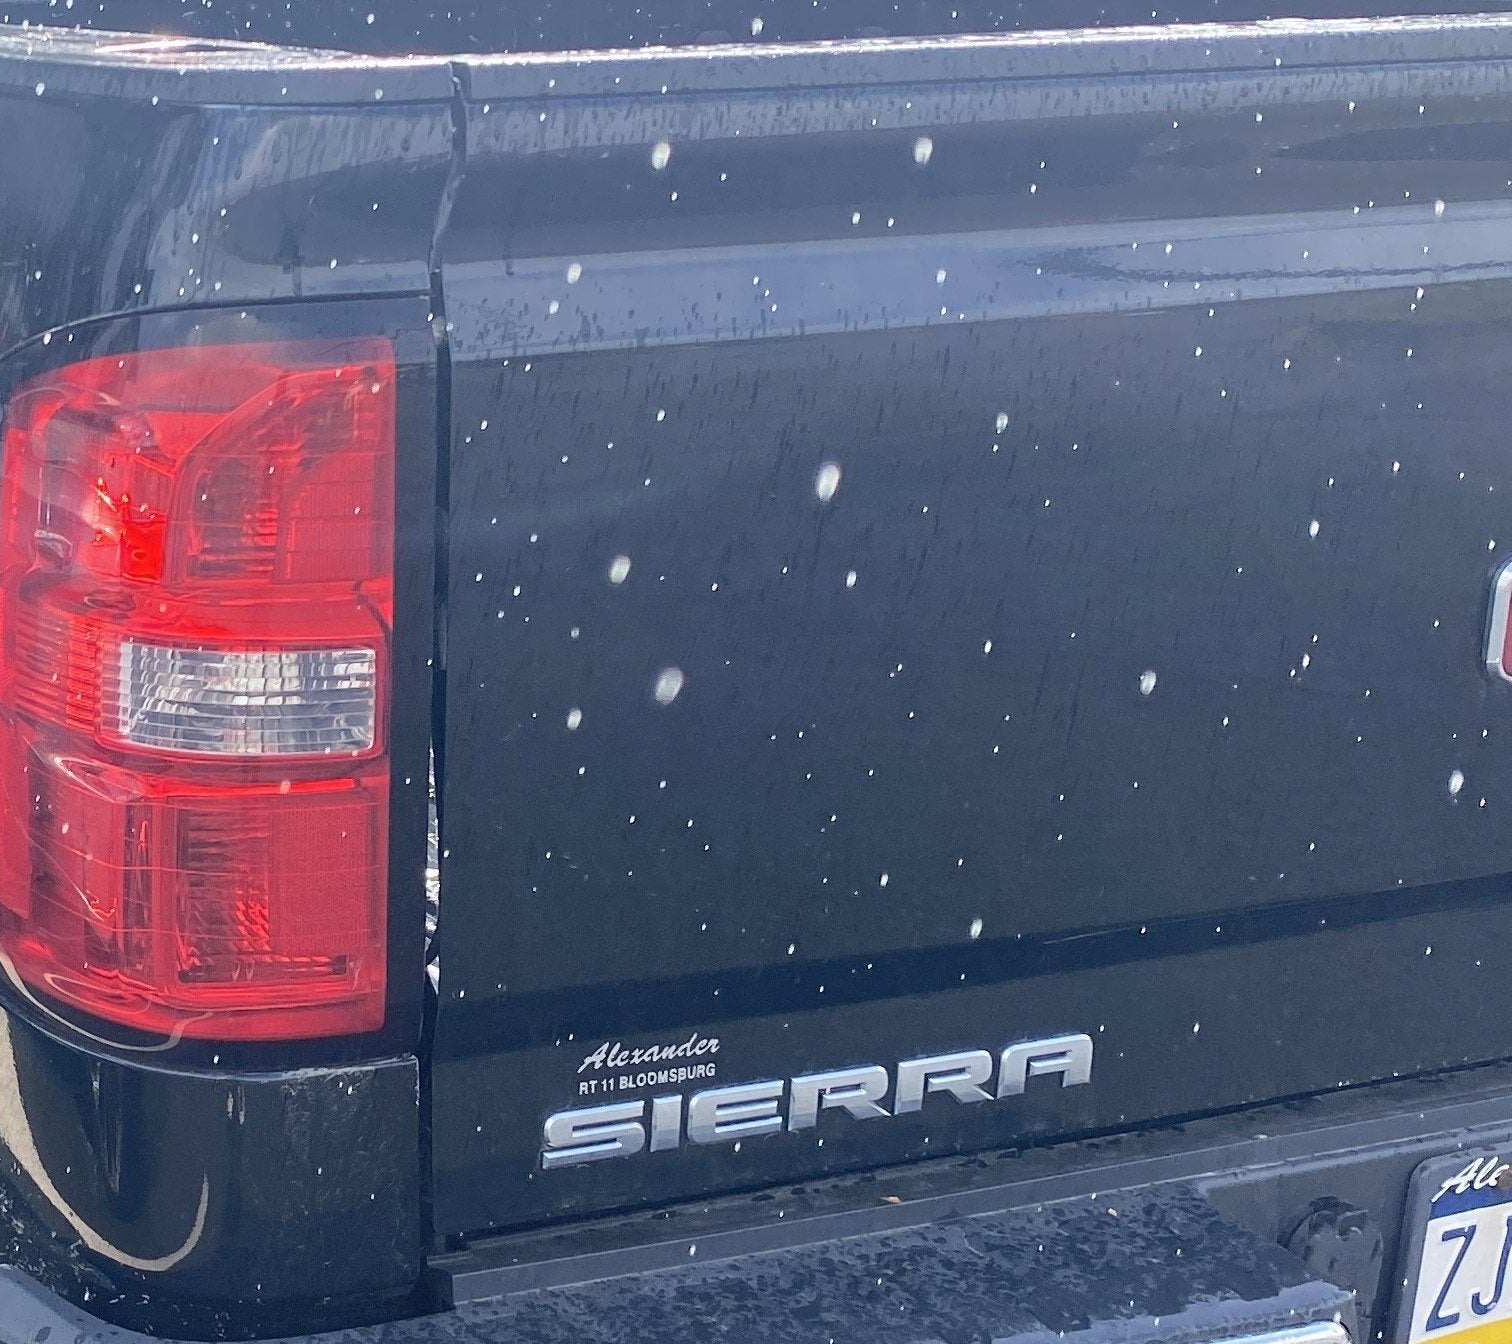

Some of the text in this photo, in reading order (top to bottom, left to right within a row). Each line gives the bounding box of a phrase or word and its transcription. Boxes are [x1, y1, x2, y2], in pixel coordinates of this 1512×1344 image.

[577, 1032, 720, 1074] Alexander
[579, 1062, 716, 1095] RT 11 BLOOMSBURG
[541, 1032, 1095, 1171] SIERRA
